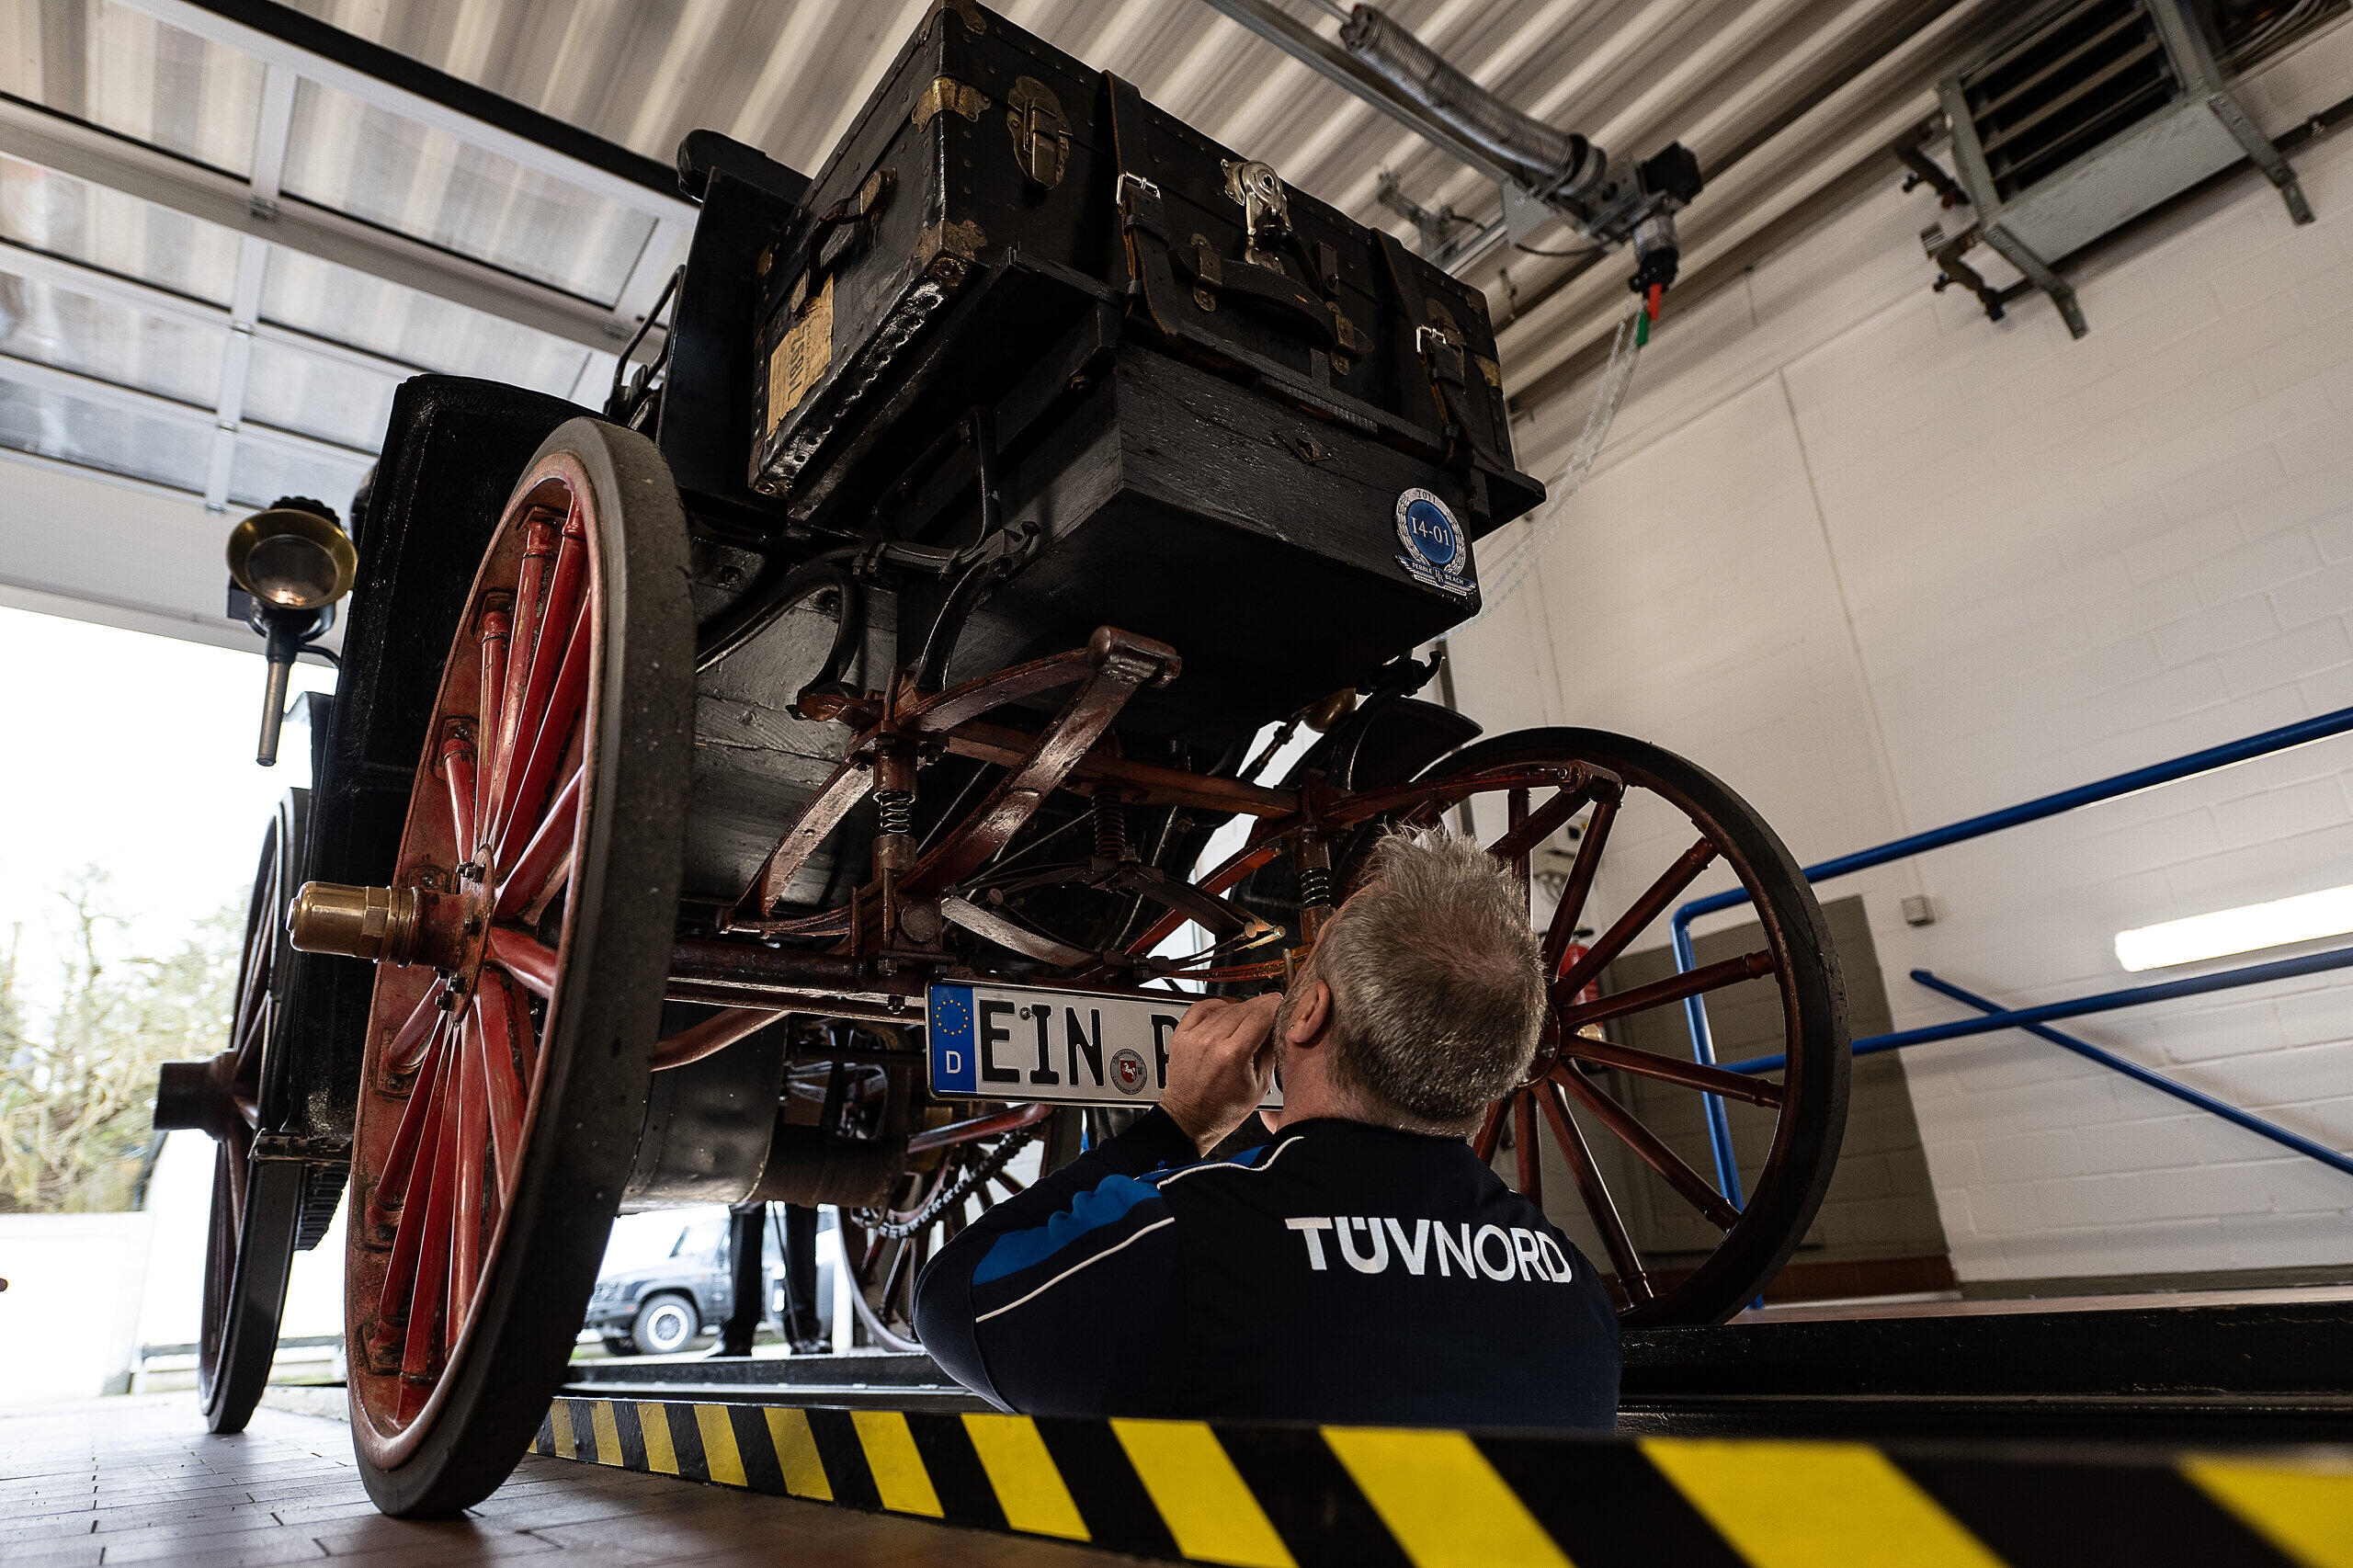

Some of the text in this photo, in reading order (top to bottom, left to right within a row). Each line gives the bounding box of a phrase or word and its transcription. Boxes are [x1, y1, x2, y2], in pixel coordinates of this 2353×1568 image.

[1416, 490, 1436, 504] 2011
[1412, 562, 1433, 574] PEBBLE
[1445, 574, 1464, 585] BEACH
[978, 999, 1105, 1087] EIN
[946, 1051, 961, 1074] D
